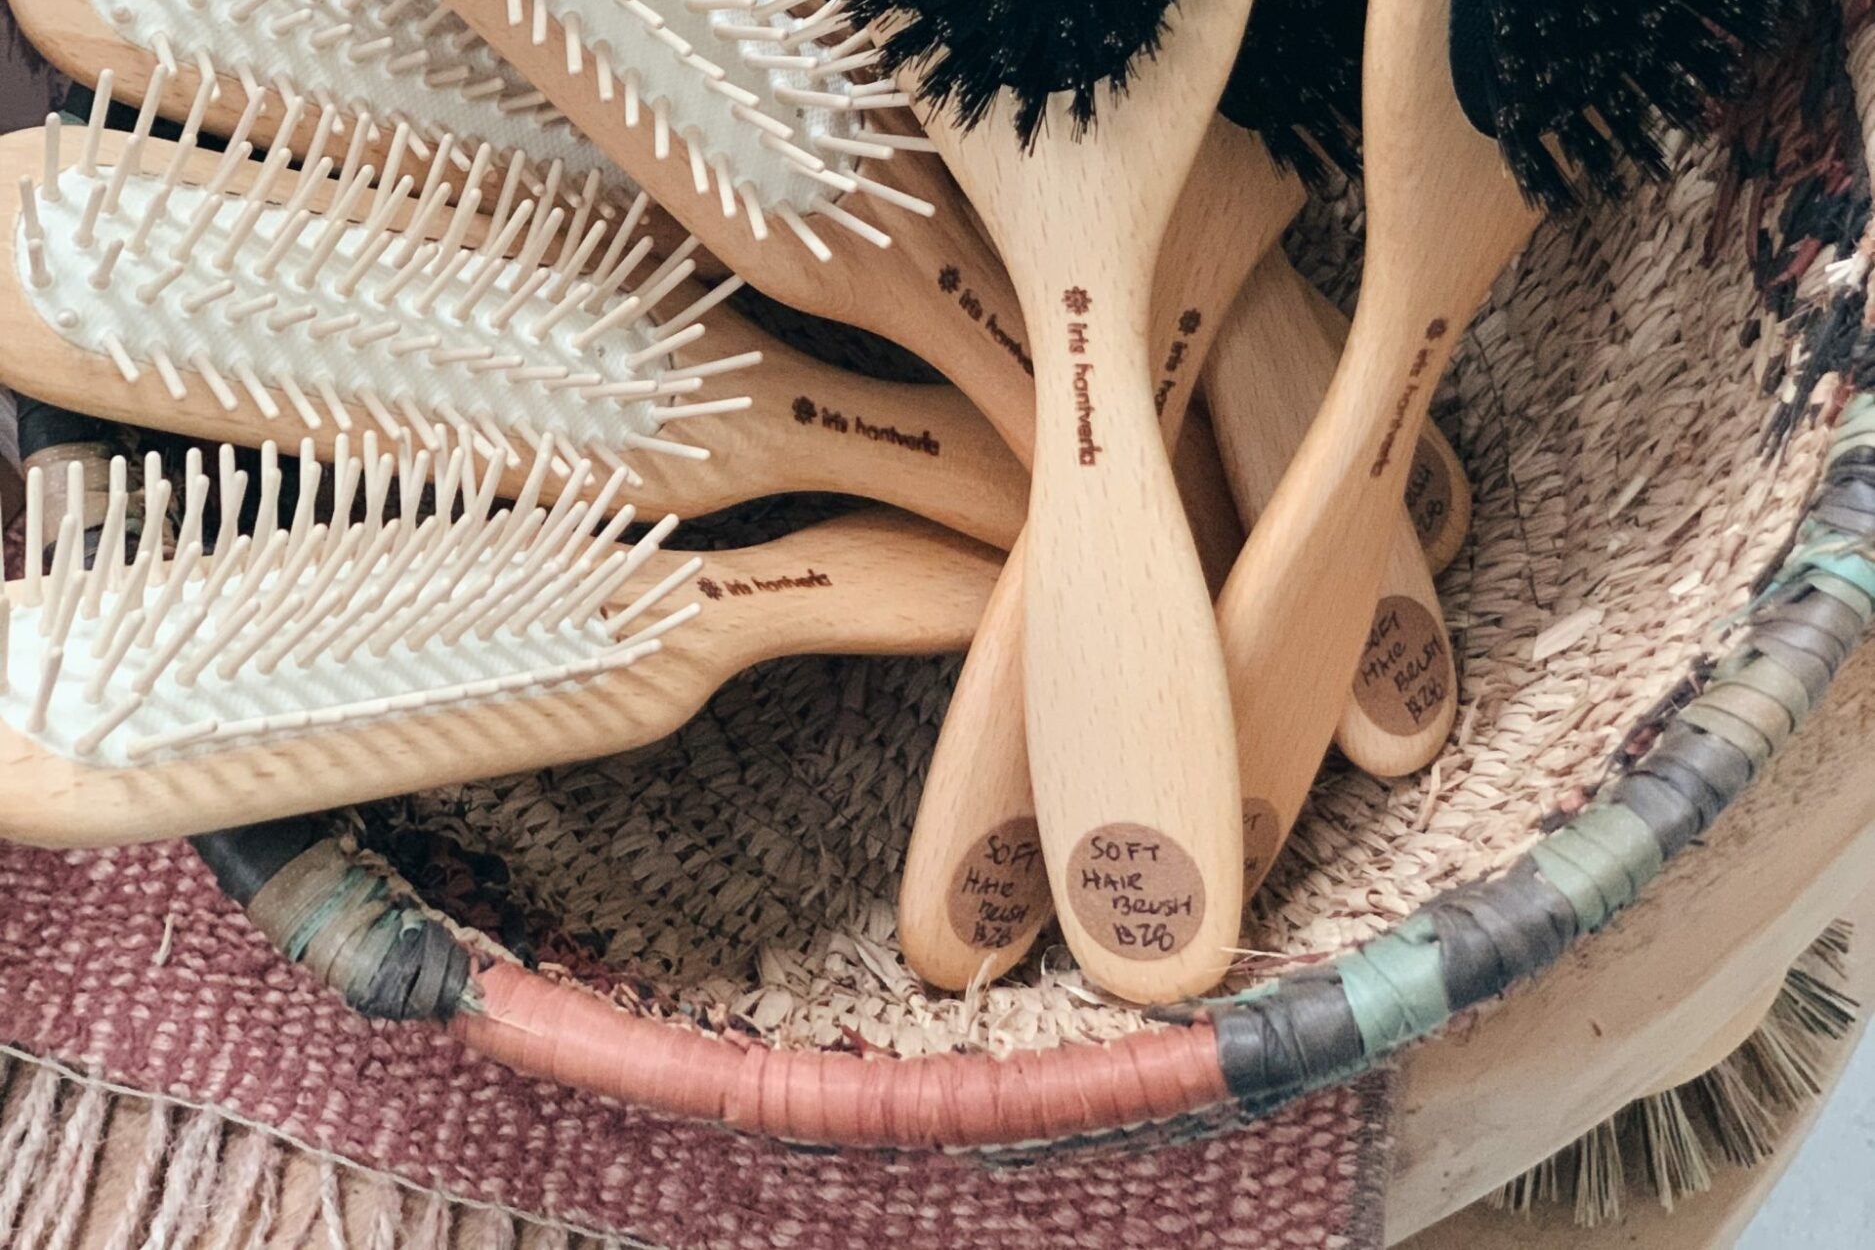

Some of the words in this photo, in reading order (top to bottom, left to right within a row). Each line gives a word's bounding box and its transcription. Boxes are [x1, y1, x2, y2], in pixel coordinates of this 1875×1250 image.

[1067, 322, 1089, 354] iris
[984, 835, 1039, 872] SOFT
[1091, 835, 1160, 861] SOFT
[1082, 868, 1143, 891] HAIR
[1112, 895, 1192, 917] BRUSH
